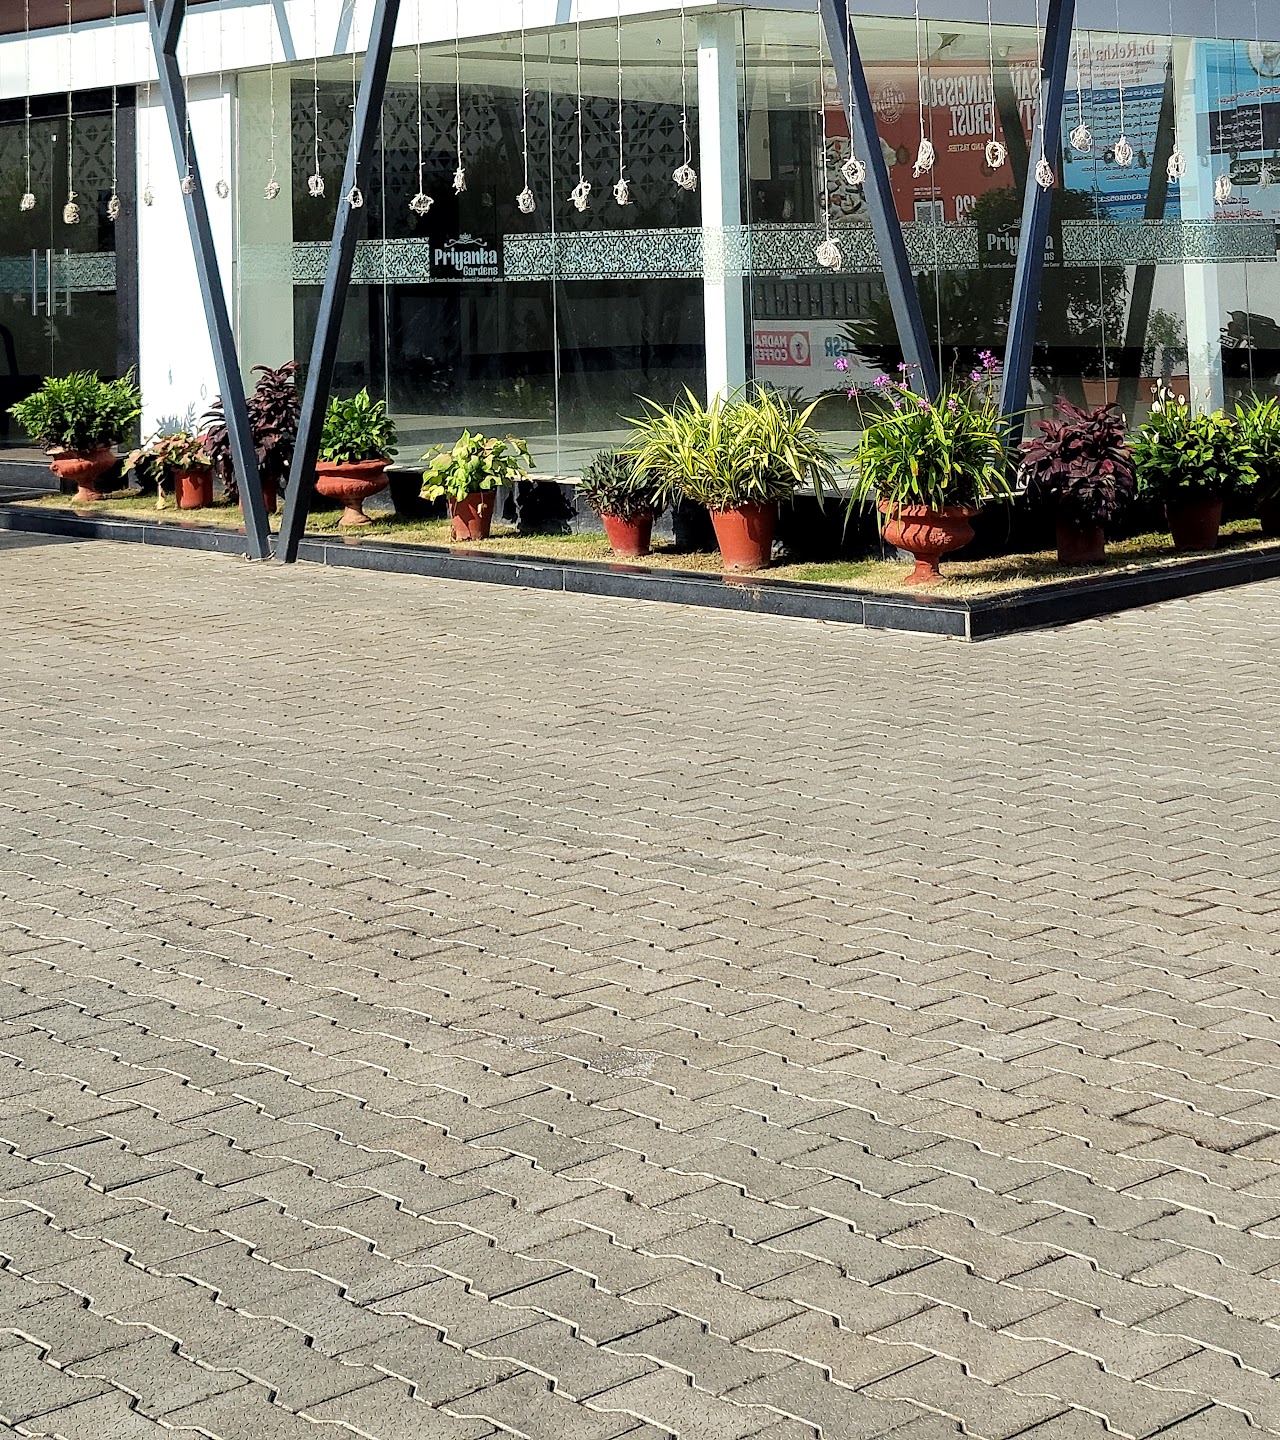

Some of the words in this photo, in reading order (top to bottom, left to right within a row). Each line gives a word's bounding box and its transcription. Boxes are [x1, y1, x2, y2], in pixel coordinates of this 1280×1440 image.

[987, 232, 1054, 256] Priya
[434, 247, 498, 271] Priyanka
[463, 265, 499, 276] Gardens
